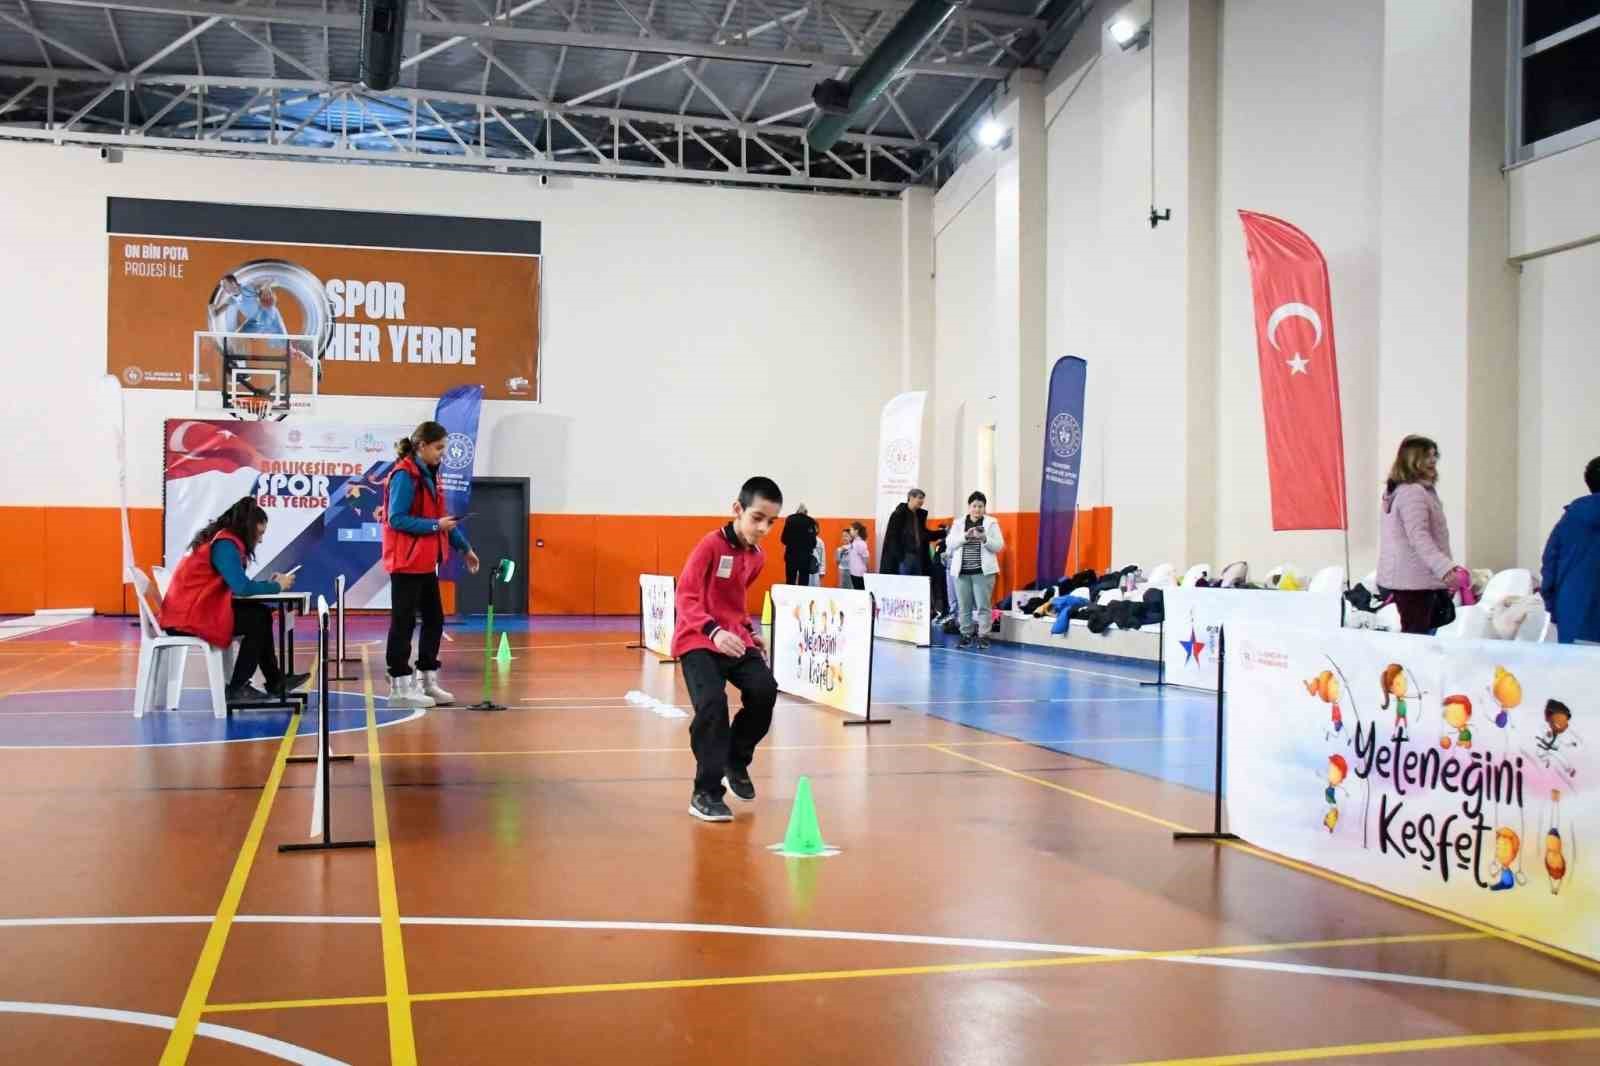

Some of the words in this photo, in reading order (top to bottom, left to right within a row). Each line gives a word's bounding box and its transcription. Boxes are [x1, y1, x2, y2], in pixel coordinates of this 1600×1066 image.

[125, 244, 140, 258] ON
[142, 243, 161, 259] BİN
[163, 246, 189, 261] POTA
[124, 261, 167, 277] PROJESİ
[325, 278, 405, 320] SPOR
[325, 323, 380, 362] HER
[387, 325, 477, 365] YERDE
[260, 460, 363, 475] BALIKESİR'DE
[257, 473, 330, 497] SPOR
[283, 496, 328, 509] YERDE
[1354, 719, 1524, 819] Yeteneğini
[1378, 793, 1492, 888] Keşfet
